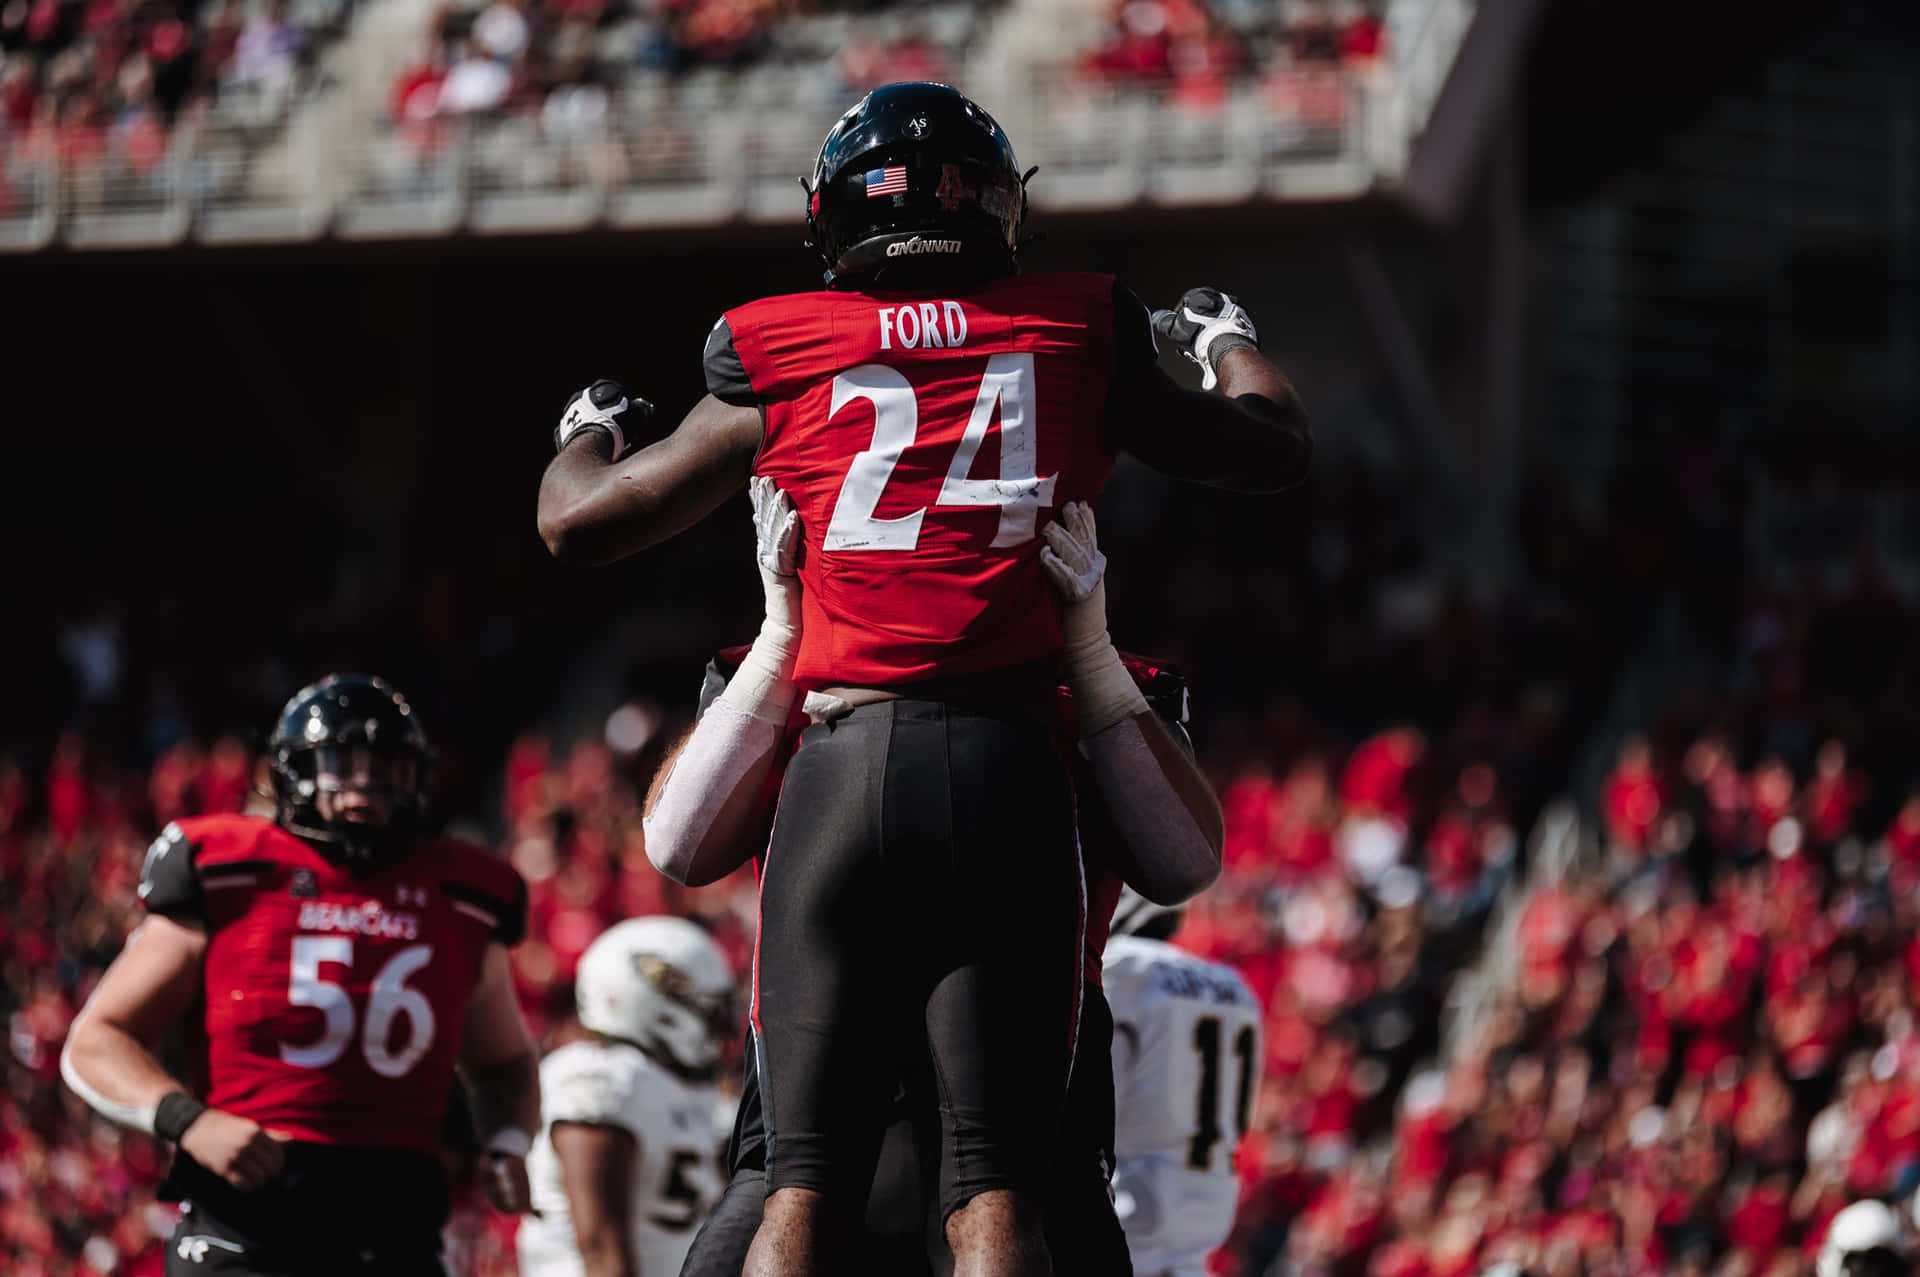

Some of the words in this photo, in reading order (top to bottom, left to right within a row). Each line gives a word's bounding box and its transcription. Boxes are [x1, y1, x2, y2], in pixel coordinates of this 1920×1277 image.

[886, 236, 961, 257] CINCINNATI
[878, 301, 968, 350] FORD
[822, 351, 1059, 552] 24
[279, 935, 434, 1078] 56
[1186, 1015, 1255, 1173] 11
